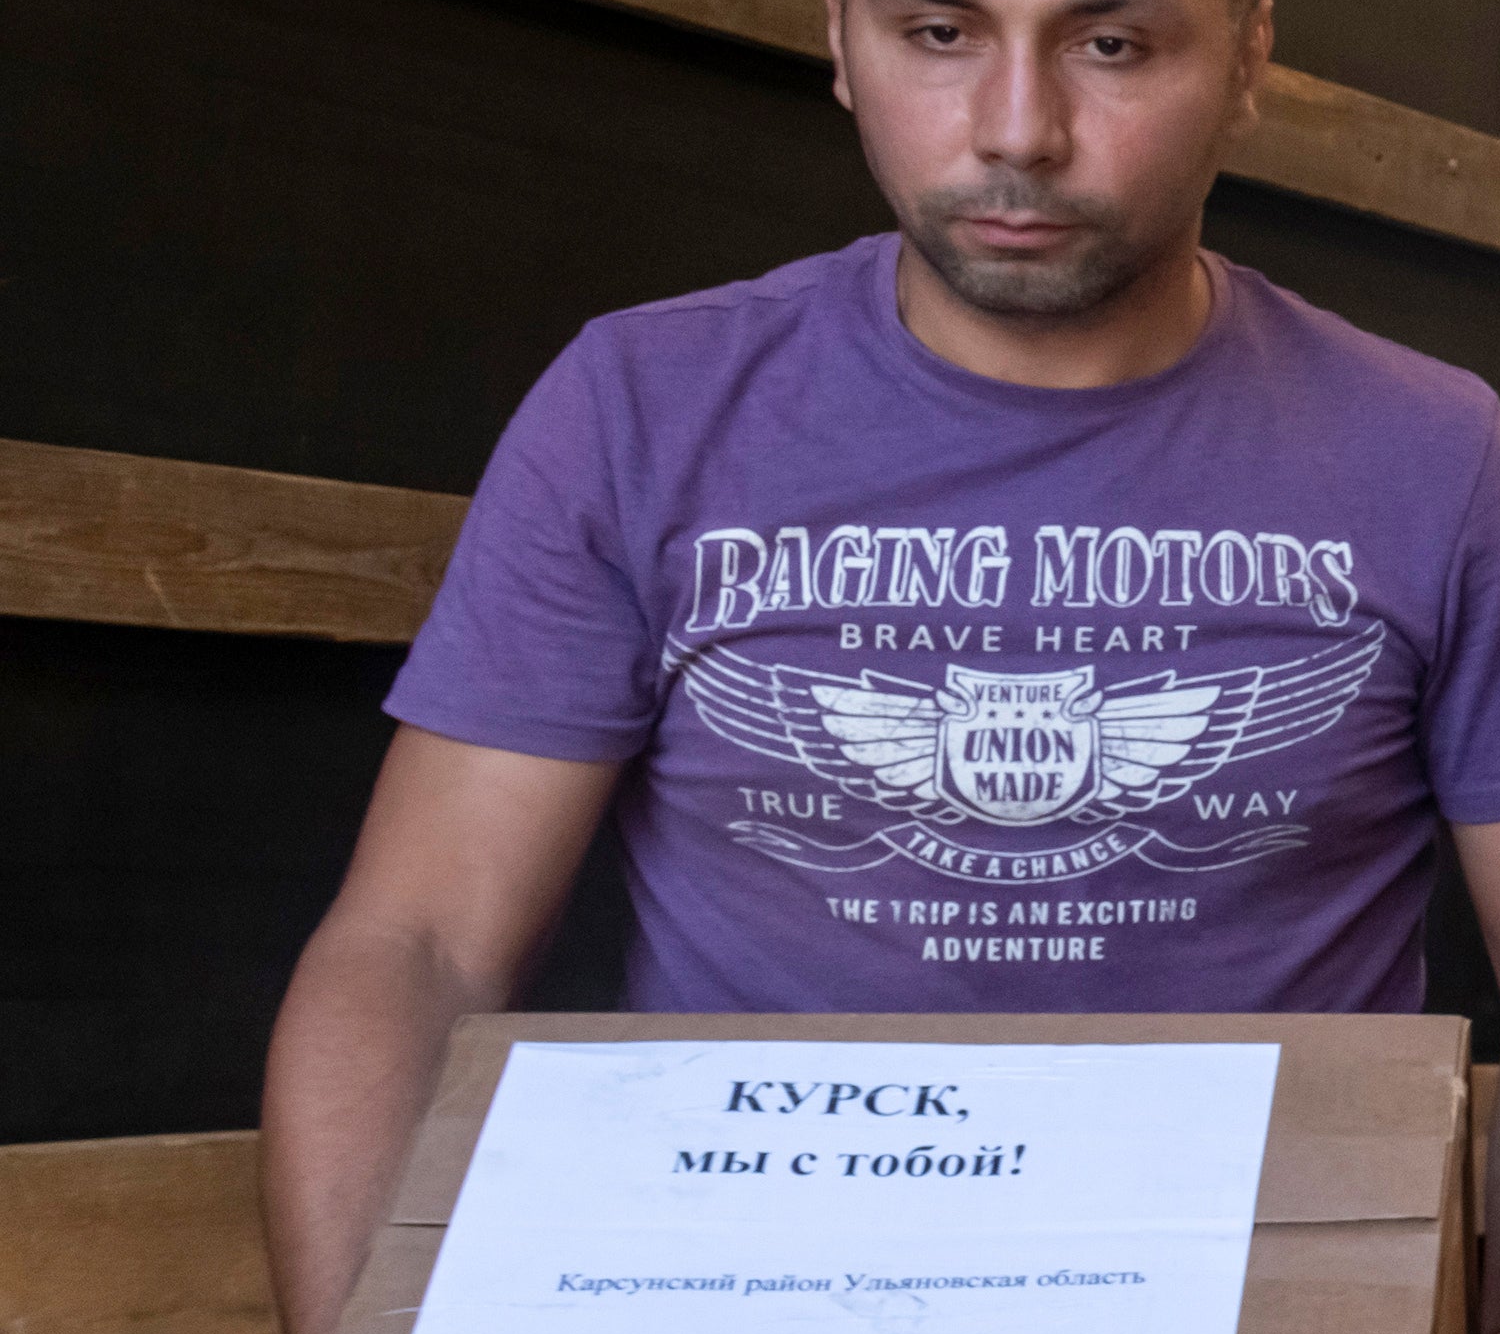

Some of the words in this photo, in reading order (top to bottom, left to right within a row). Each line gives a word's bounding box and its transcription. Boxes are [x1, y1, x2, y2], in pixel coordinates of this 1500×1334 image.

[686, 525, 1012, 633] RAGING
[1030, 523, 1359, 627] MOTORS
[840, 622, 1004, 653] BRAVE
[1035, 624, 1199, 654] HEART
[971, 681, 1064, 705] VENTURE
[963, 728, 1077, 763] UNION
[738, 786, 843, 821] TRUE
[973, 769, 1064, 804] MADE
[1194, 788, 1300, 820] WAY
[904, 830, 978, 878] TAKE
[986, 856, 1002, 879] A
[1011, 831, 1129, 880] CHANCE
[826, 897, 879, 925] THE
[890, 898, 961, 925] TRIP
[968, 898, 998, 925] IS
[1007, 898, 1050, 925] AN
[1057, 897, 1198, 926] EXCITING
[921, 934, 1106, 962] ADVENTURE
[723, 1077, 973, 1128] КУРСК,
[670, 1145, 771, 1179] мы
[788, 1147, 819, 1178] с
[835, 1138, 1029, 1181] тобой!
[555, 1268, 738, 1299] Карсунский
[743, 1271, 834, 1299] район
[842, 1267, 1030, 1296] Ульяновская
[1036, 1265, 1148, 1294] область
